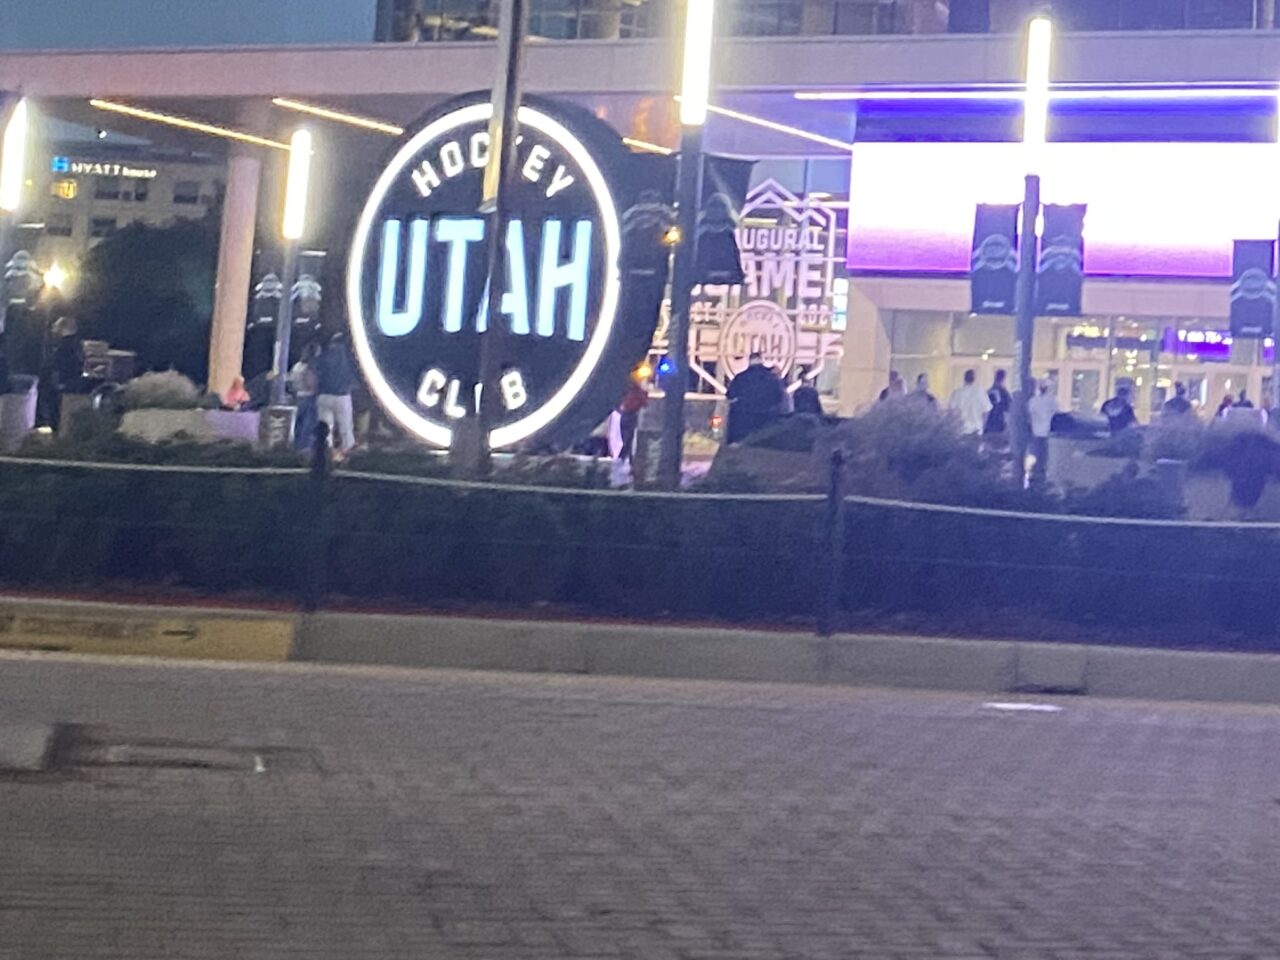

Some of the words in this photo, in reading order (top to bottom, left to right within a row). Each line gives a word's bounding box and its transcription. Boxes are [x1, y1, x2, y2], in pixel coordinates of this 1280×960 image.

[71, 162, 120, 176] HYATT
[411, 132, 574, 198] HOCEY
[376, 218, 592, 341] UTAH
[741, 252, 825, 299] AME
